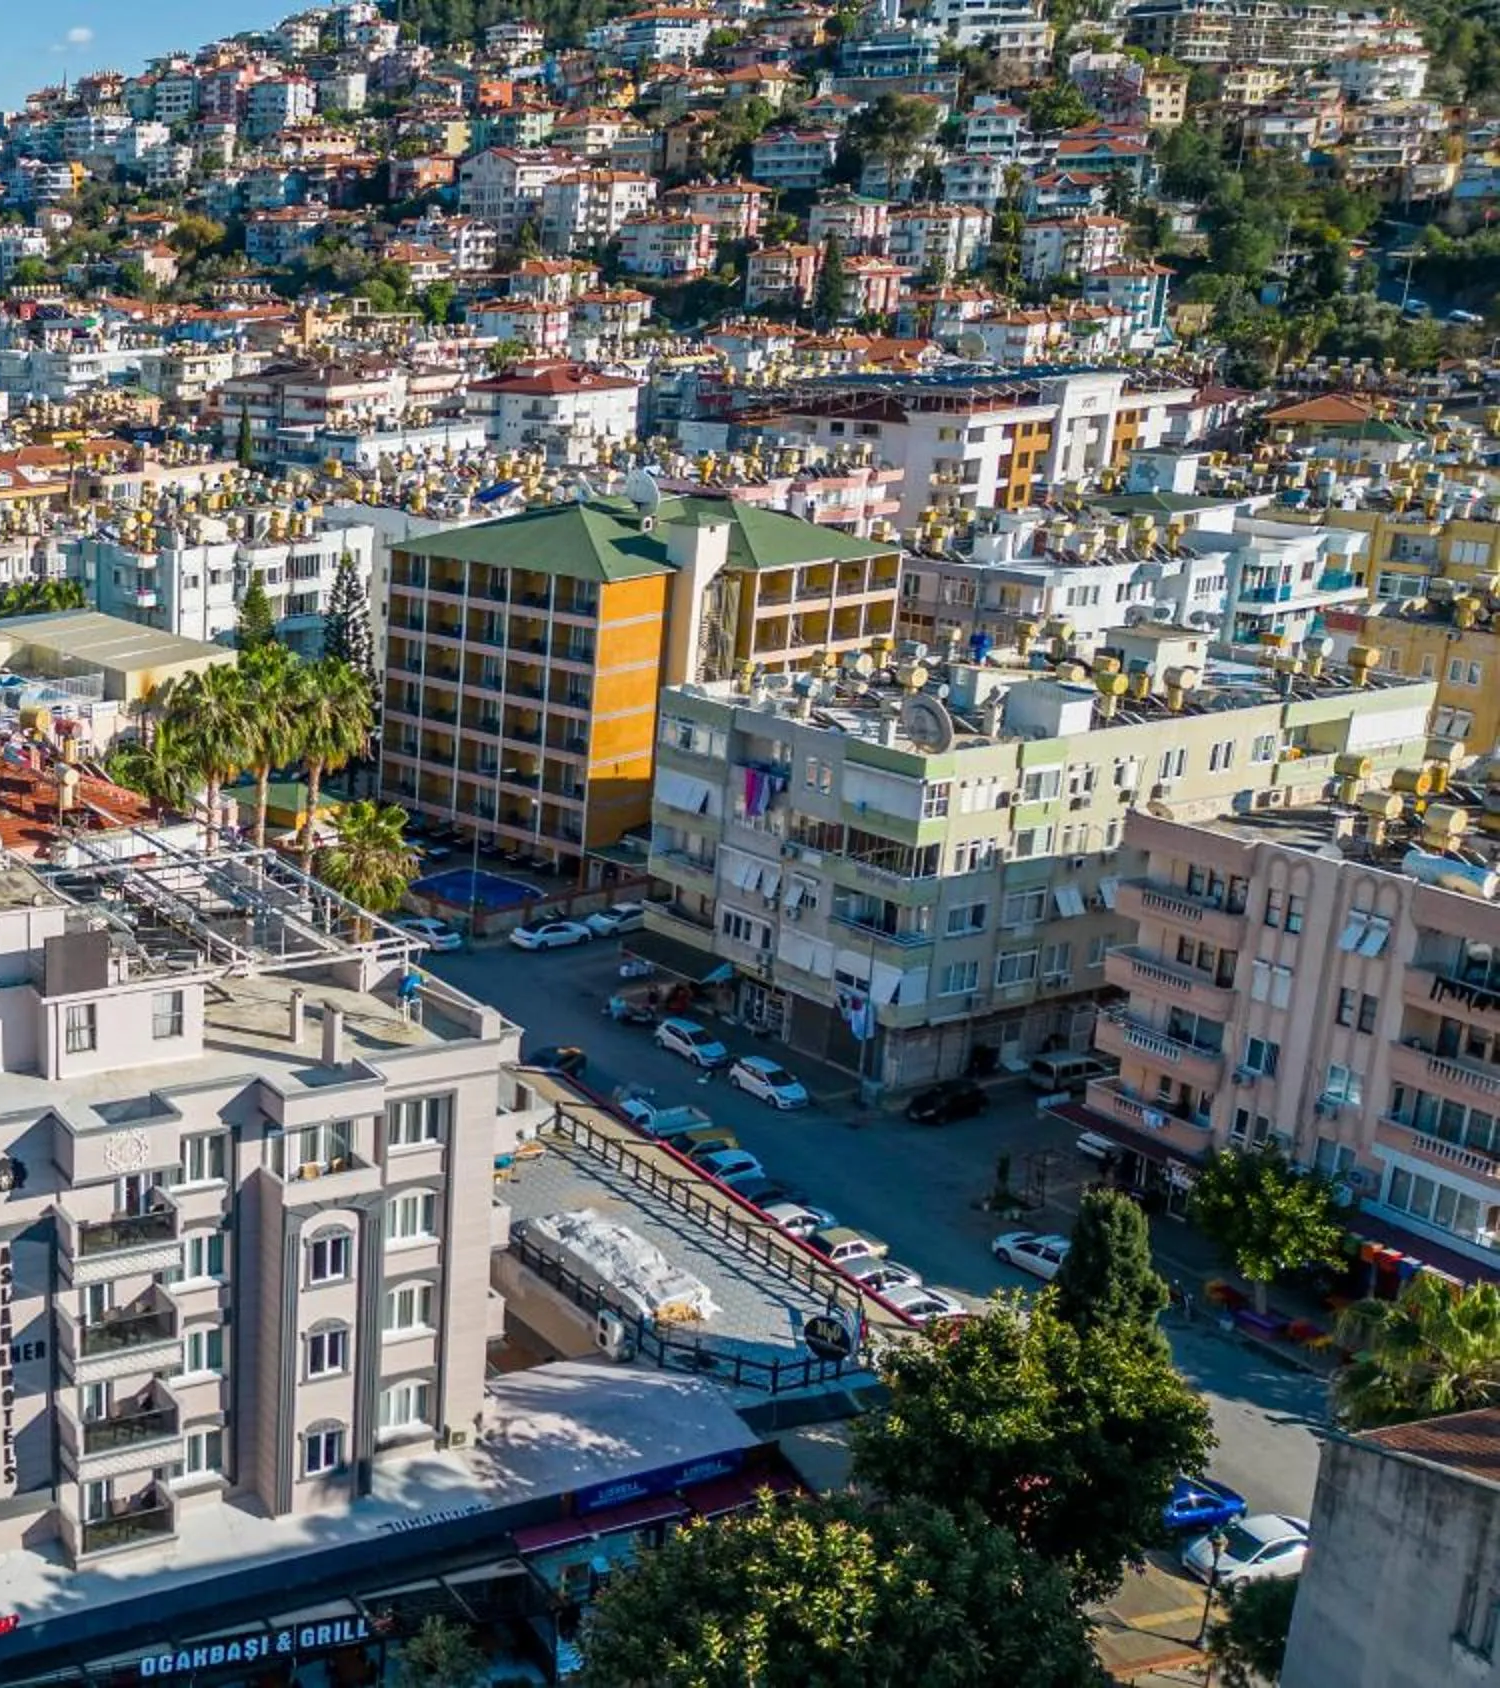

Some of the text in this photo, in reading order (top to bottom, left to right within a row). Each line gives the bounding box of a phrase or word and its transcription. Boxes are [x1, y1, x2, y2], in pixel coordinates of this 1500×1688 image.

[1, 1370, 16, 1484] HOTELS
[276, 1632, 292, 1652] &
[301, 1618, 370, 1648] GRILL
